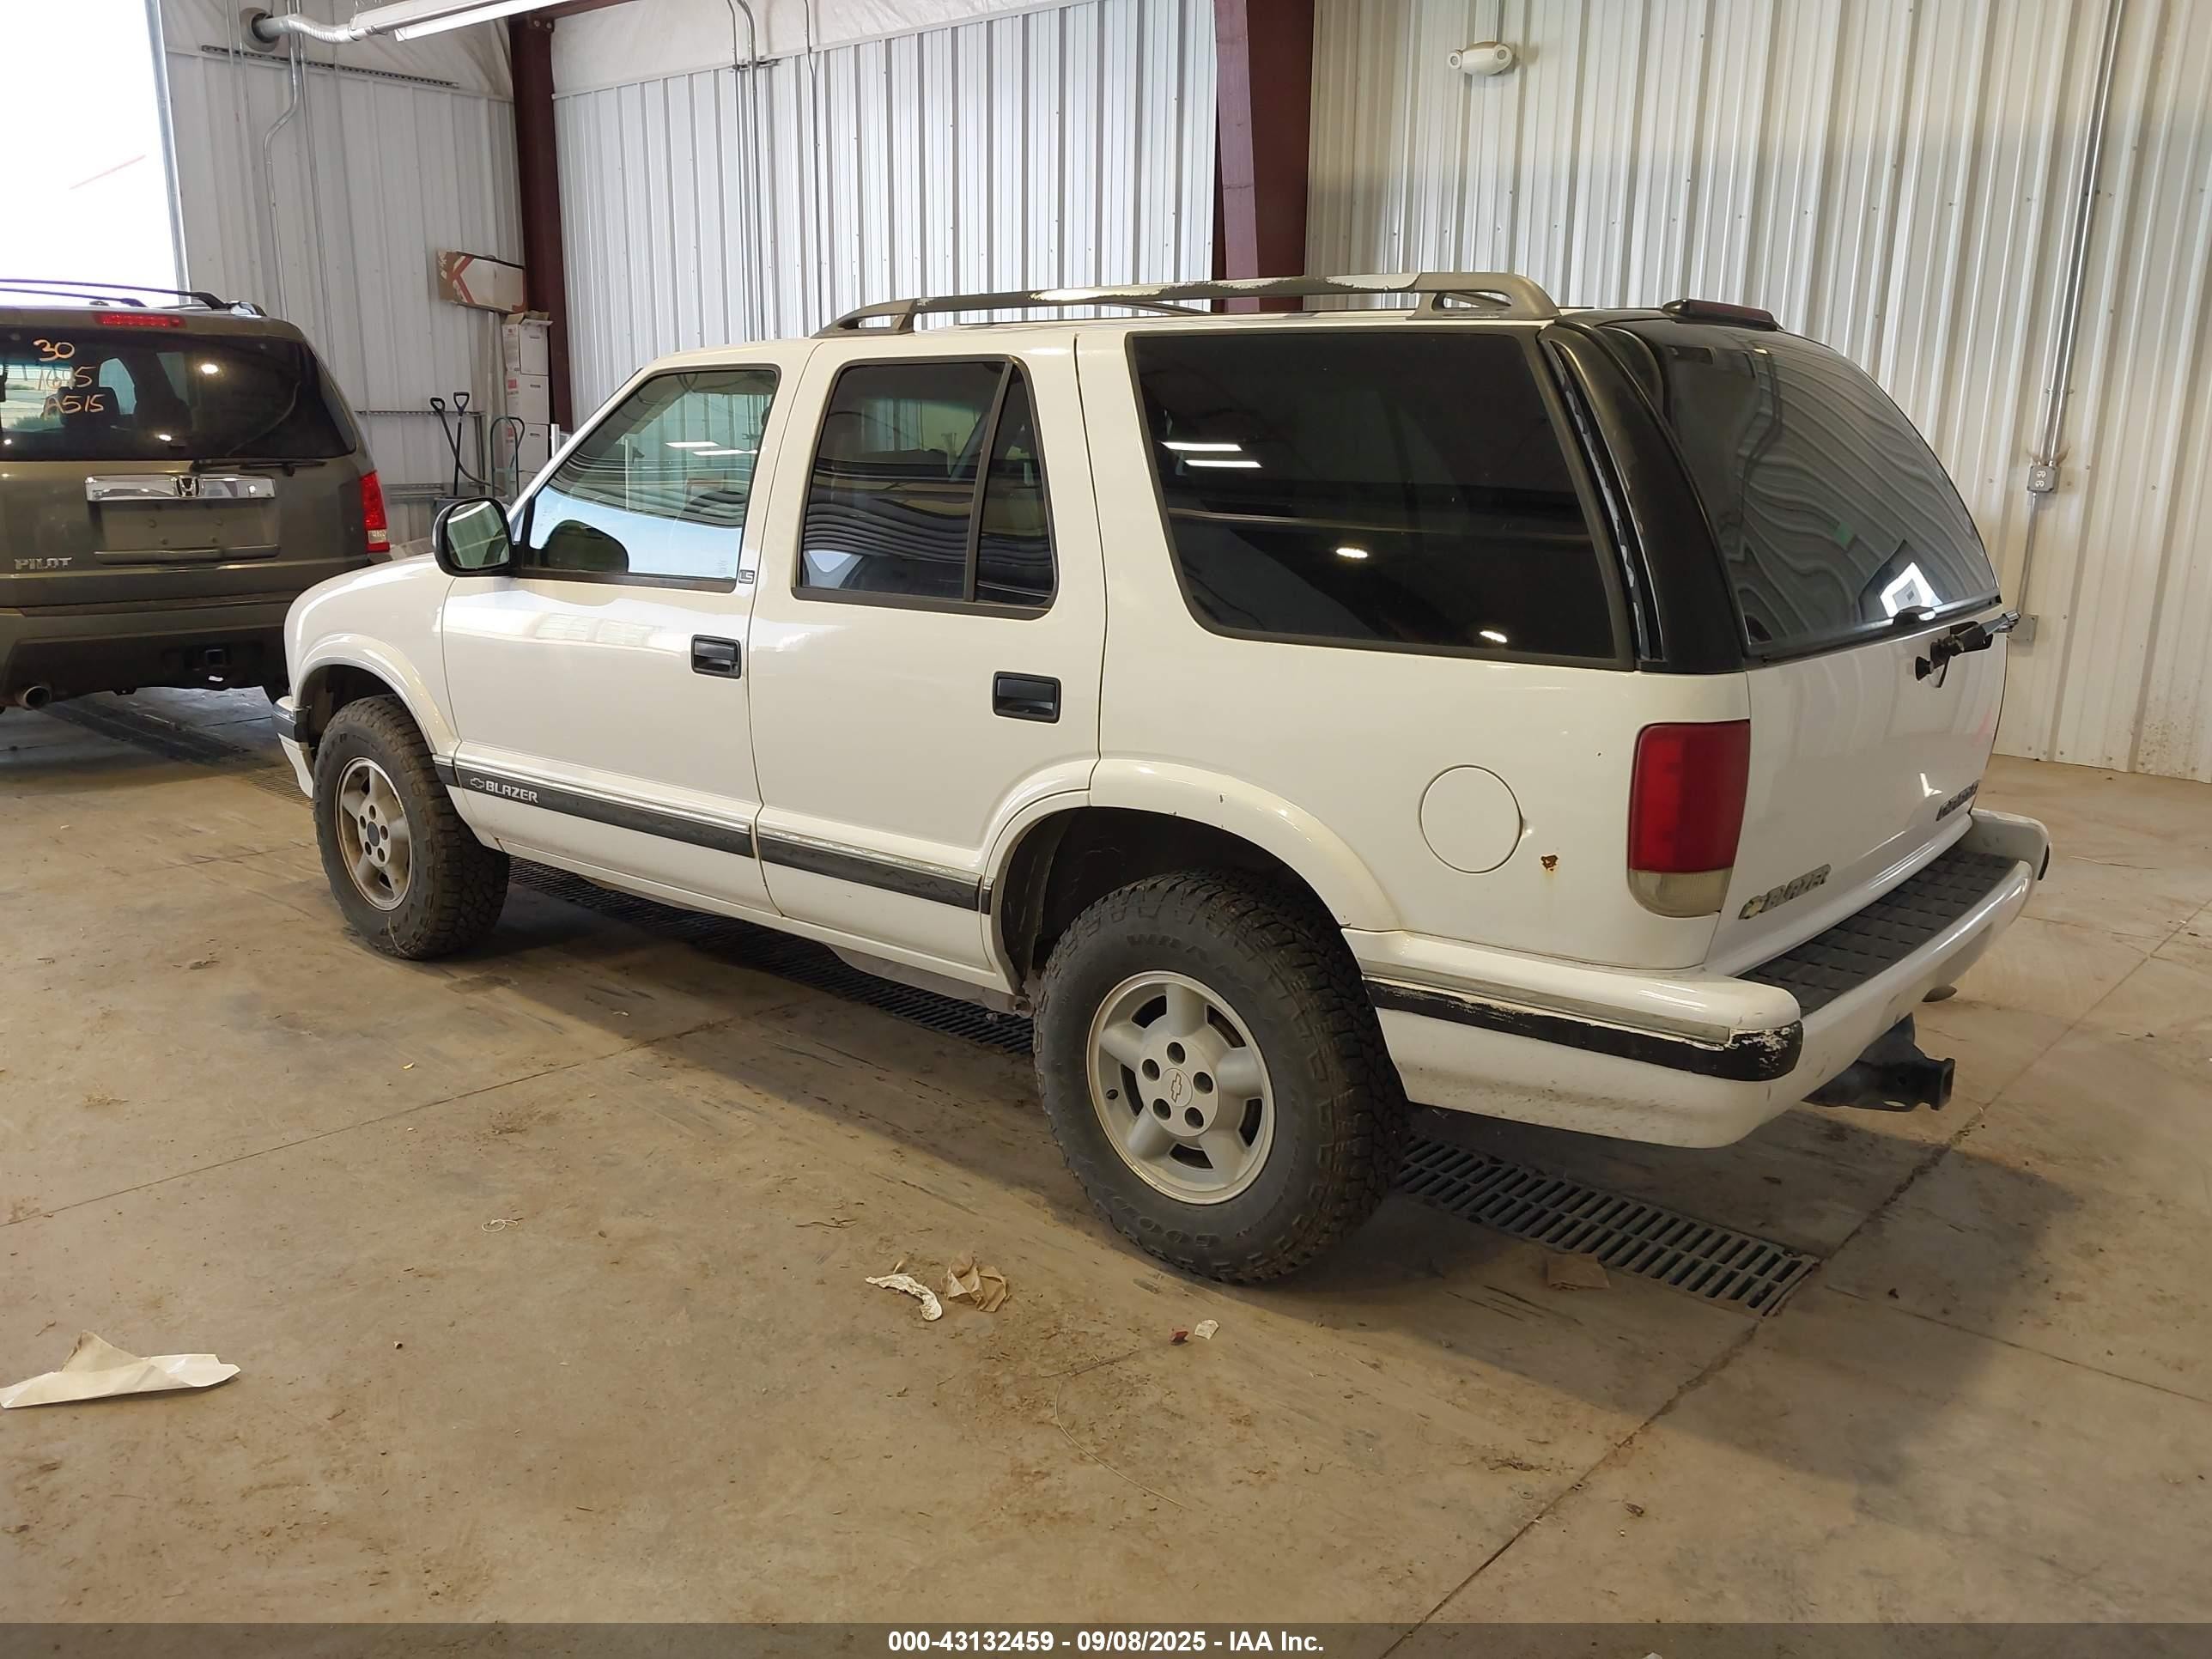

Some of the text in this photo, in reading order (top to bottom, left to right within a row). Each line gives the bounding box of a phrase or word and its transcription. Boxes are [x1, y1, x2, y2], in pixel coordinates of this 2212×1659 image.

[33, 339, 75, 362] 30
[15, 557, 72, 569] PILOT
[739, 569, 755, 584] LS
[485, 780, 539, 804] BLAZER
